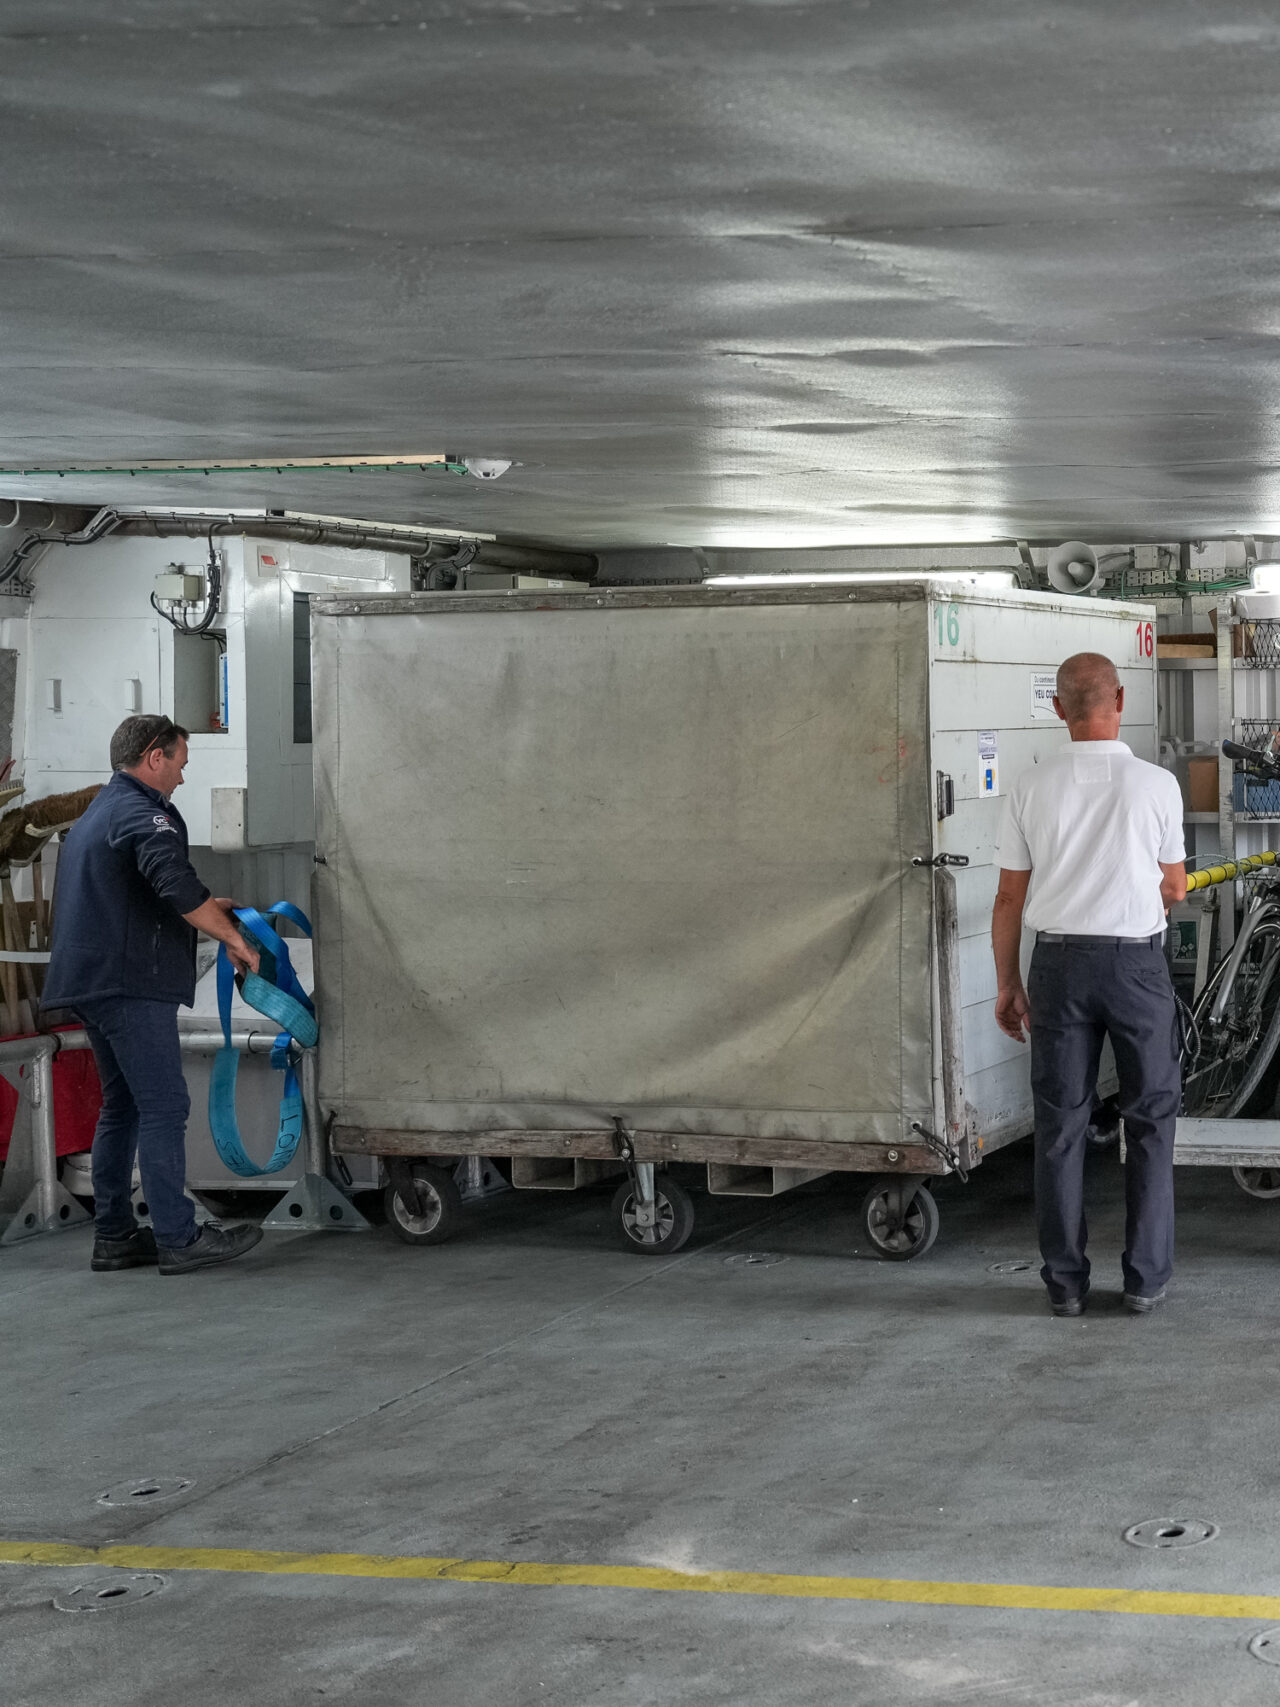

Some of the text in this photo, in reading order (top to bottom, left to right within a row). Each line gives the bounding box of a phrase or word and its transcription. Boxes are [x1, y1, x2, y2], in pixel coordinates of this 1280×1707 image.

[934, 603, 960, 647] 16
[1136, 621, 1153, 658] 16
[1035, 690, 1044, 698] YEU
